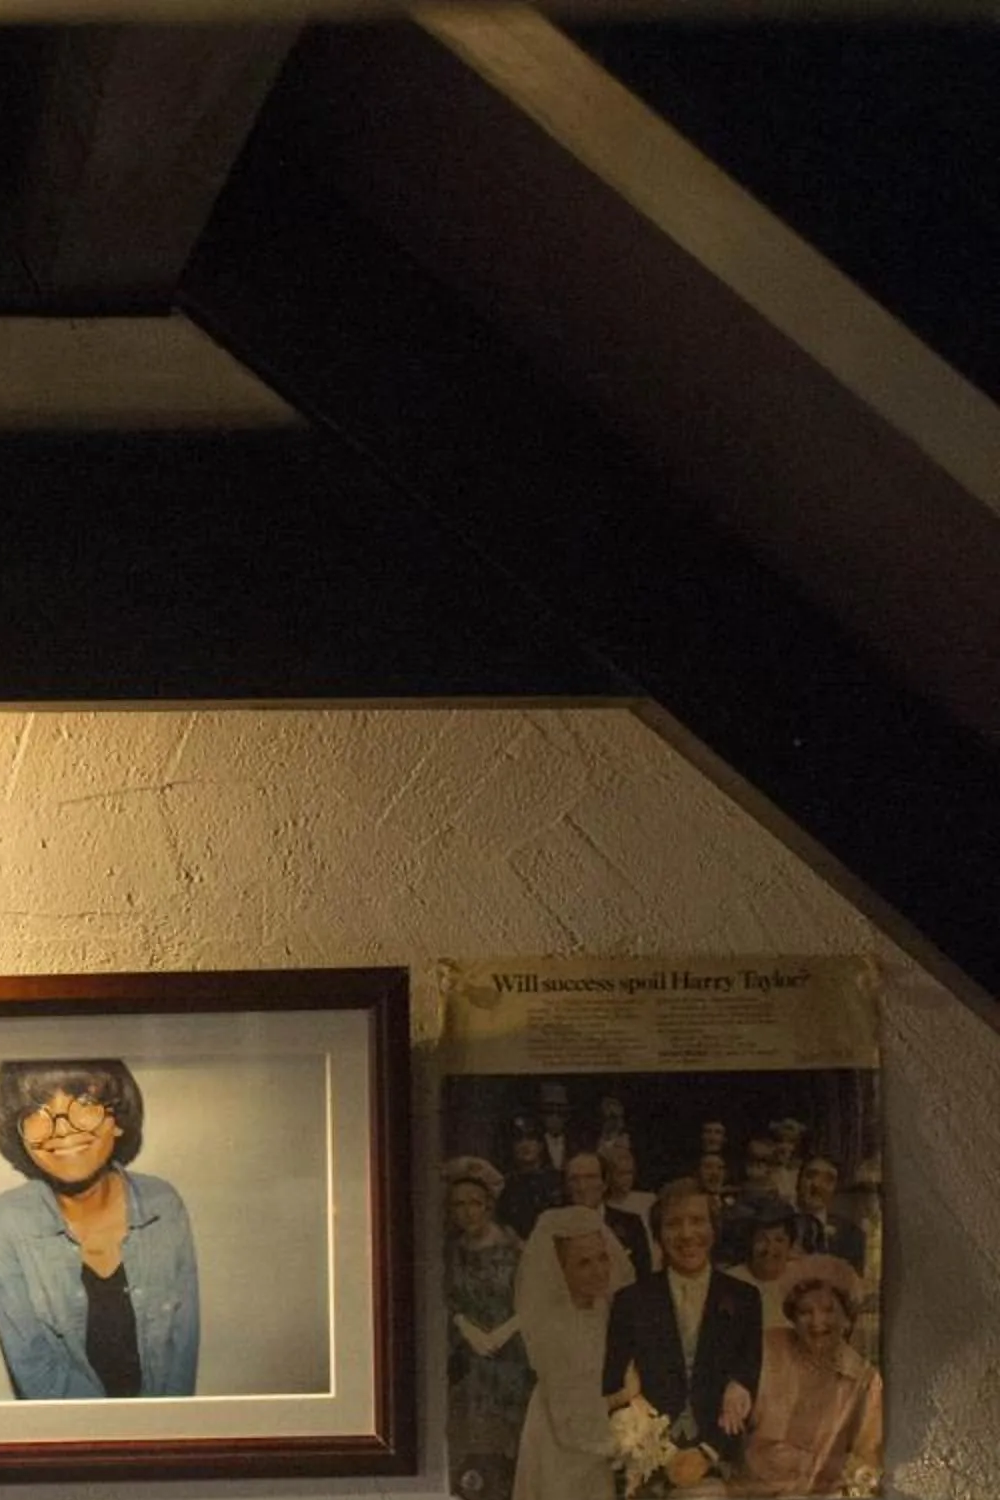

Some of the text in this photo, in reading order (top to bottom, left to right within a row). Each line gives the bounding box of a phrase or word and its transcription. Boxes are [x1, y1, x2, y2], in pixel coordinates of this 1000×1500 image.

[493, 973, 538, 993] Will
[541, 977, 615, 993] success
[620, 973, 666, 996] spoil
[671, 972, 735, 996] Harry
